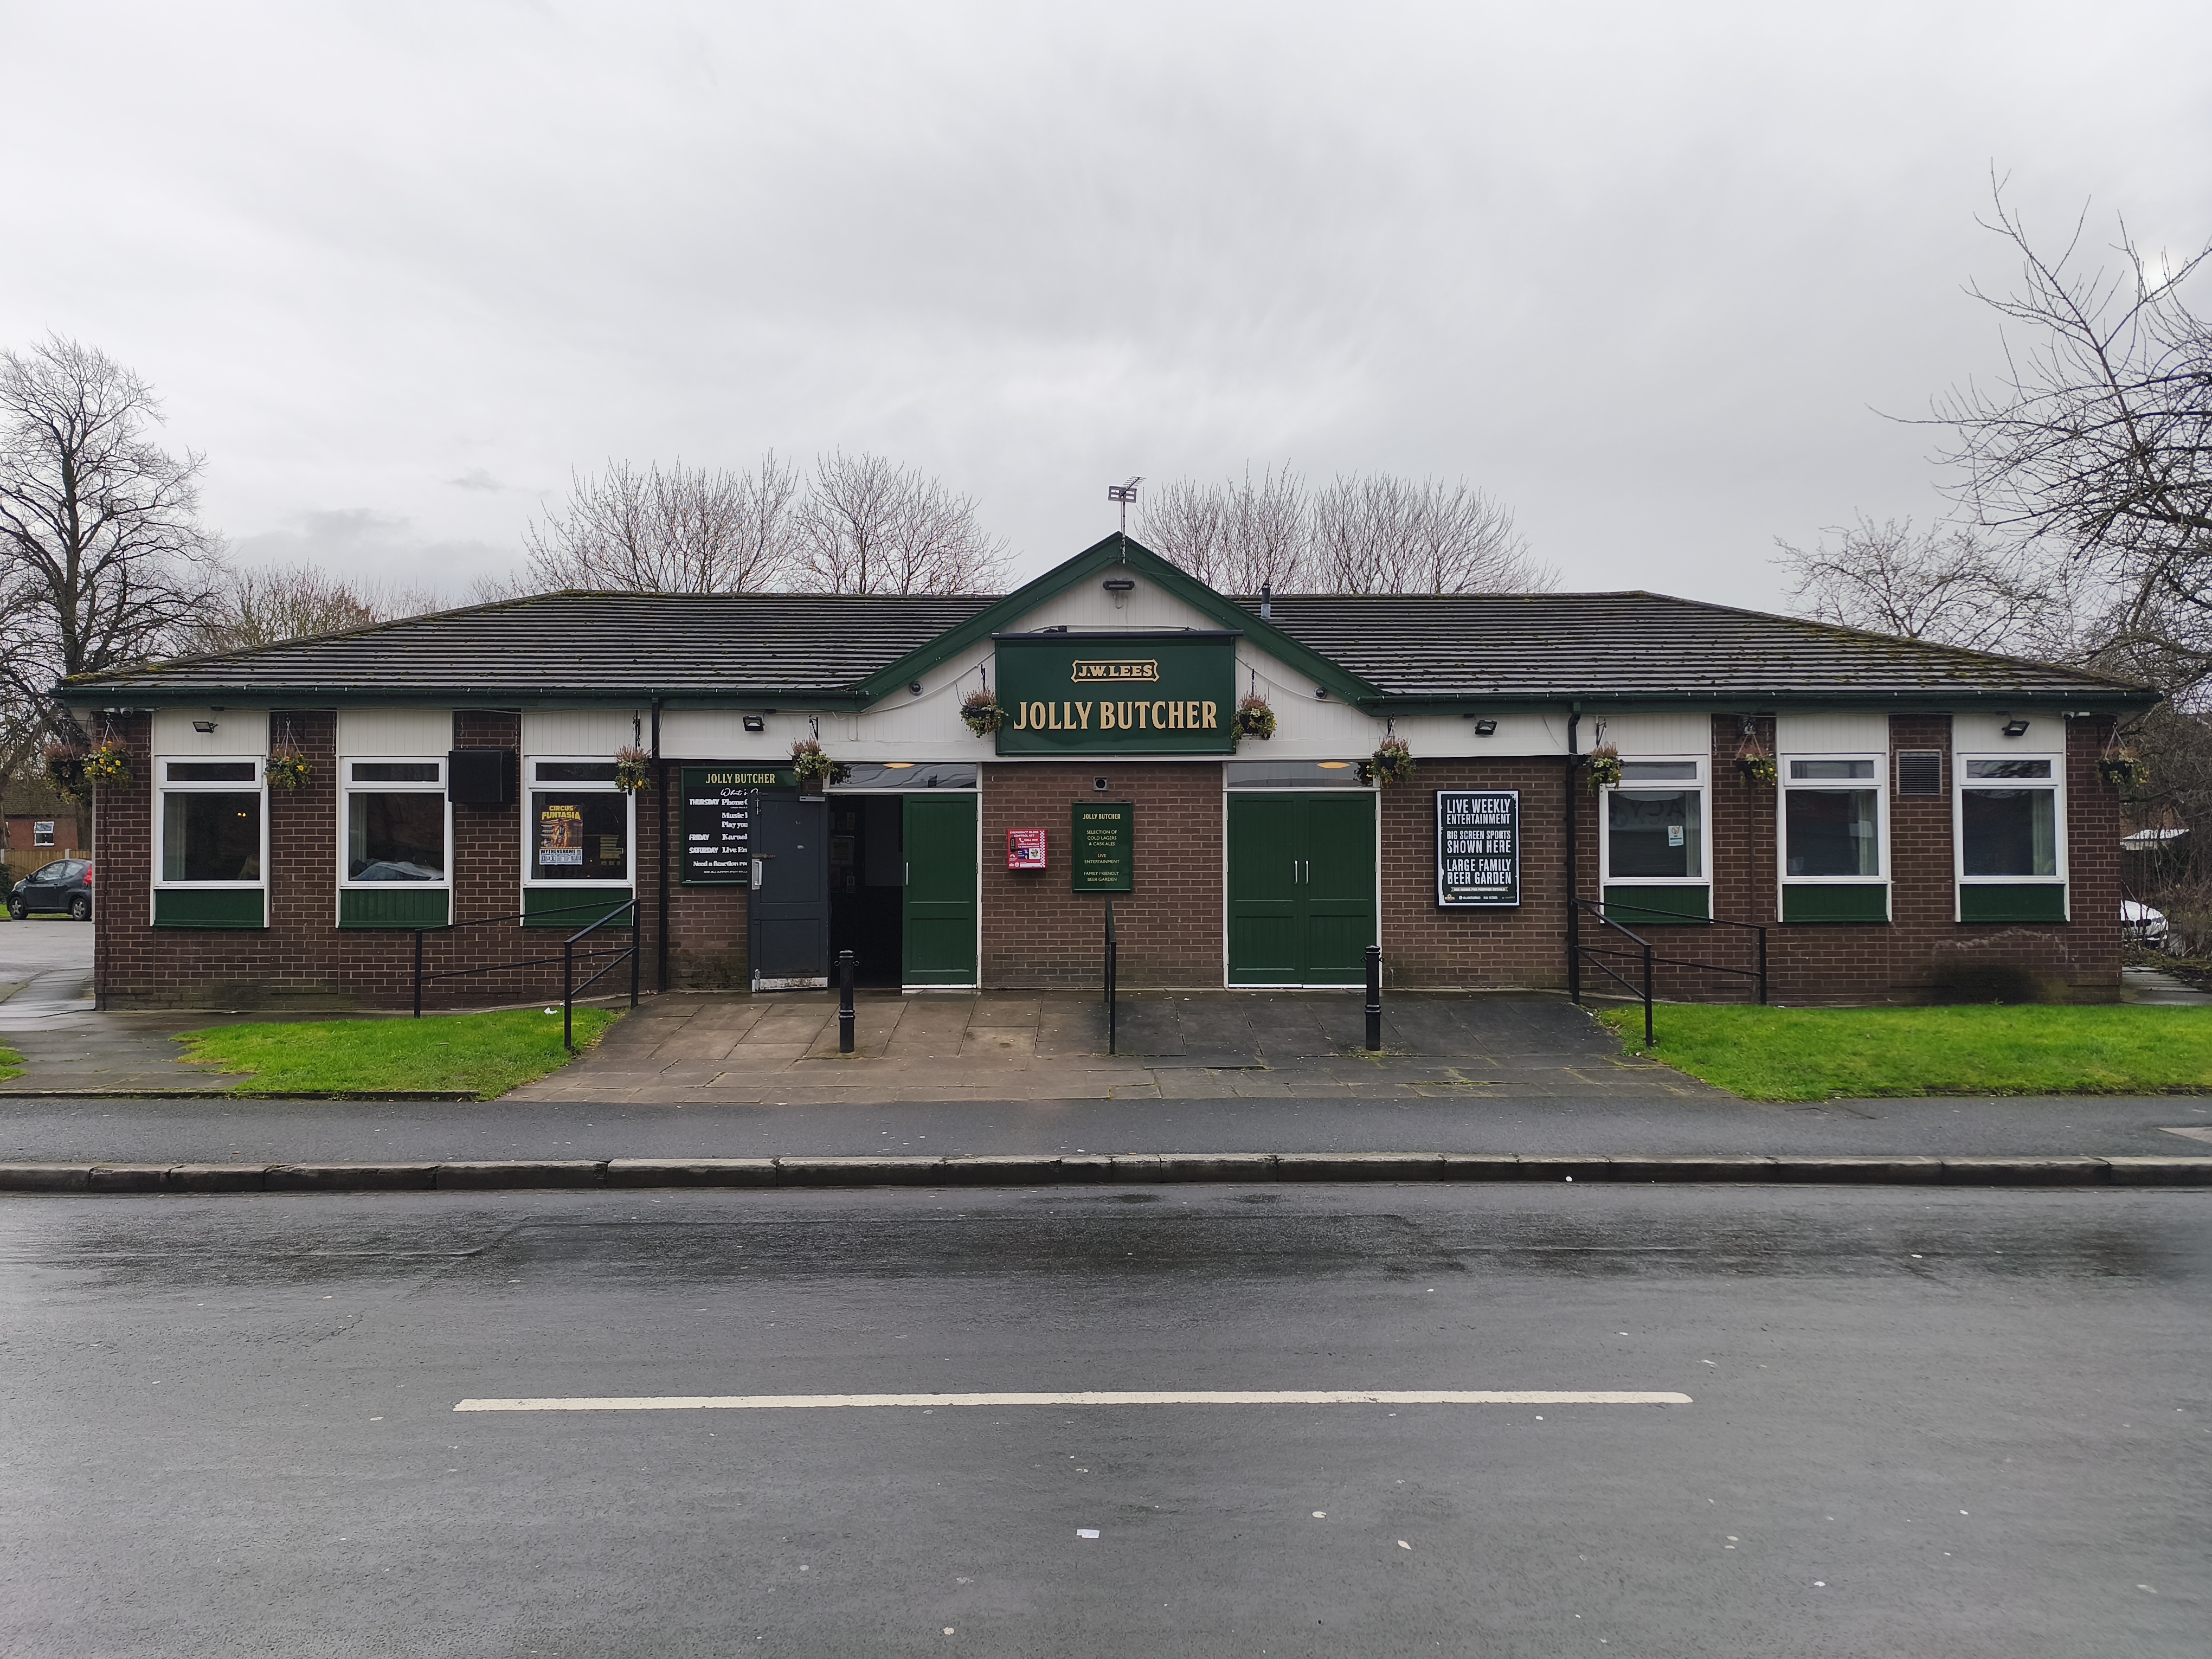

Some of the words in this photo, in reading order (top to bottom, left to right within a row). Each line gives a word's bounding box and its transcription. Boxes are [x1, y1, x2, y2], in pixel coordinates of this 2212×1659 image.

[1013, 702, 1092, 730] JOLLY
[1099, 701, 1217, 729] BUTCHER
[705, 774, 732, 783] JOLLY
[735, 774, 775, 783] BUTCHER
[1446, 799, 1469, 813] LIVE
[1471, 799, 1511, 813] WEEKLY
[542, 812, 581, 820] FUNTASIA
[1446, 813, 1511, 825] ENTERTAINMENT
[1446, 831, 1457, 840] BIG
[1459, 831, 1484, 840] SCREEN
[1486, 830, 1511, 839] SPORTS
[1446, 840, 1482, 853] SHOWN
[1486, 840, 1511, 853] HERE
[1446, 859, 1476, 871] LARGE
[1479, 859, 1511, 871] FAMILY
[1447, 872, 1471, 884] BEER
[1474, 872, 1512, 884] GARDEN
